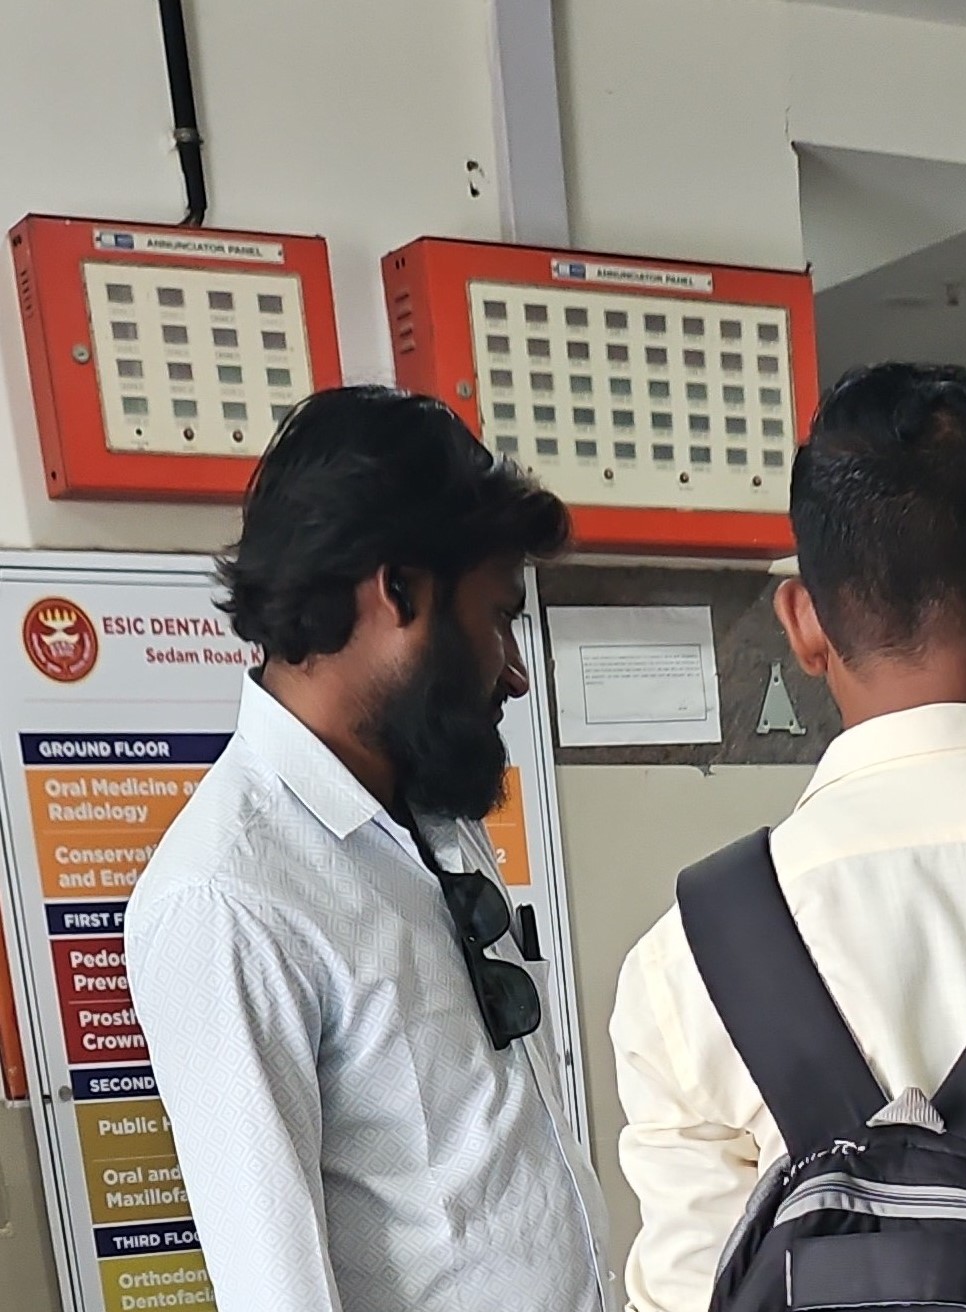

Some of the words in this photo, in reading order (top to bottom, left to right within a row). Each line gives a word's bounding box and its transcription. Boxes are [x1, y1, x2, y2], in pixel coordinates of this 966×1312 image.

[102, 616, 145, 635] ESIC
[150, 618, 225, 636] DENTAL
[145, 647, 199, 663] Sedam
[202, 648, 246, 666] Road,
[38, 741, 111, 757] GROUND
[114, 741, 169, 756] FLOOR
[44, 778, 86, 797] Oral
[91, 778, 177, 796] Medicine
[48, 802, 147, 822] Radiology
[59, 871, 95, 888] and
[63, 912, 109, 927] FIRST
[89, 1076, 154, 1092] SECOND
[98, 1116, 157, 1135] Public
[103, 1169, 143, 1186] Oral
[149, 1167, 180, 1184] and
[107, 1189, 187, 1209] Maxillofa
[113, 1236, 161, 1251] THIRD
[118, 1269, 205, 1288] Orthodon
